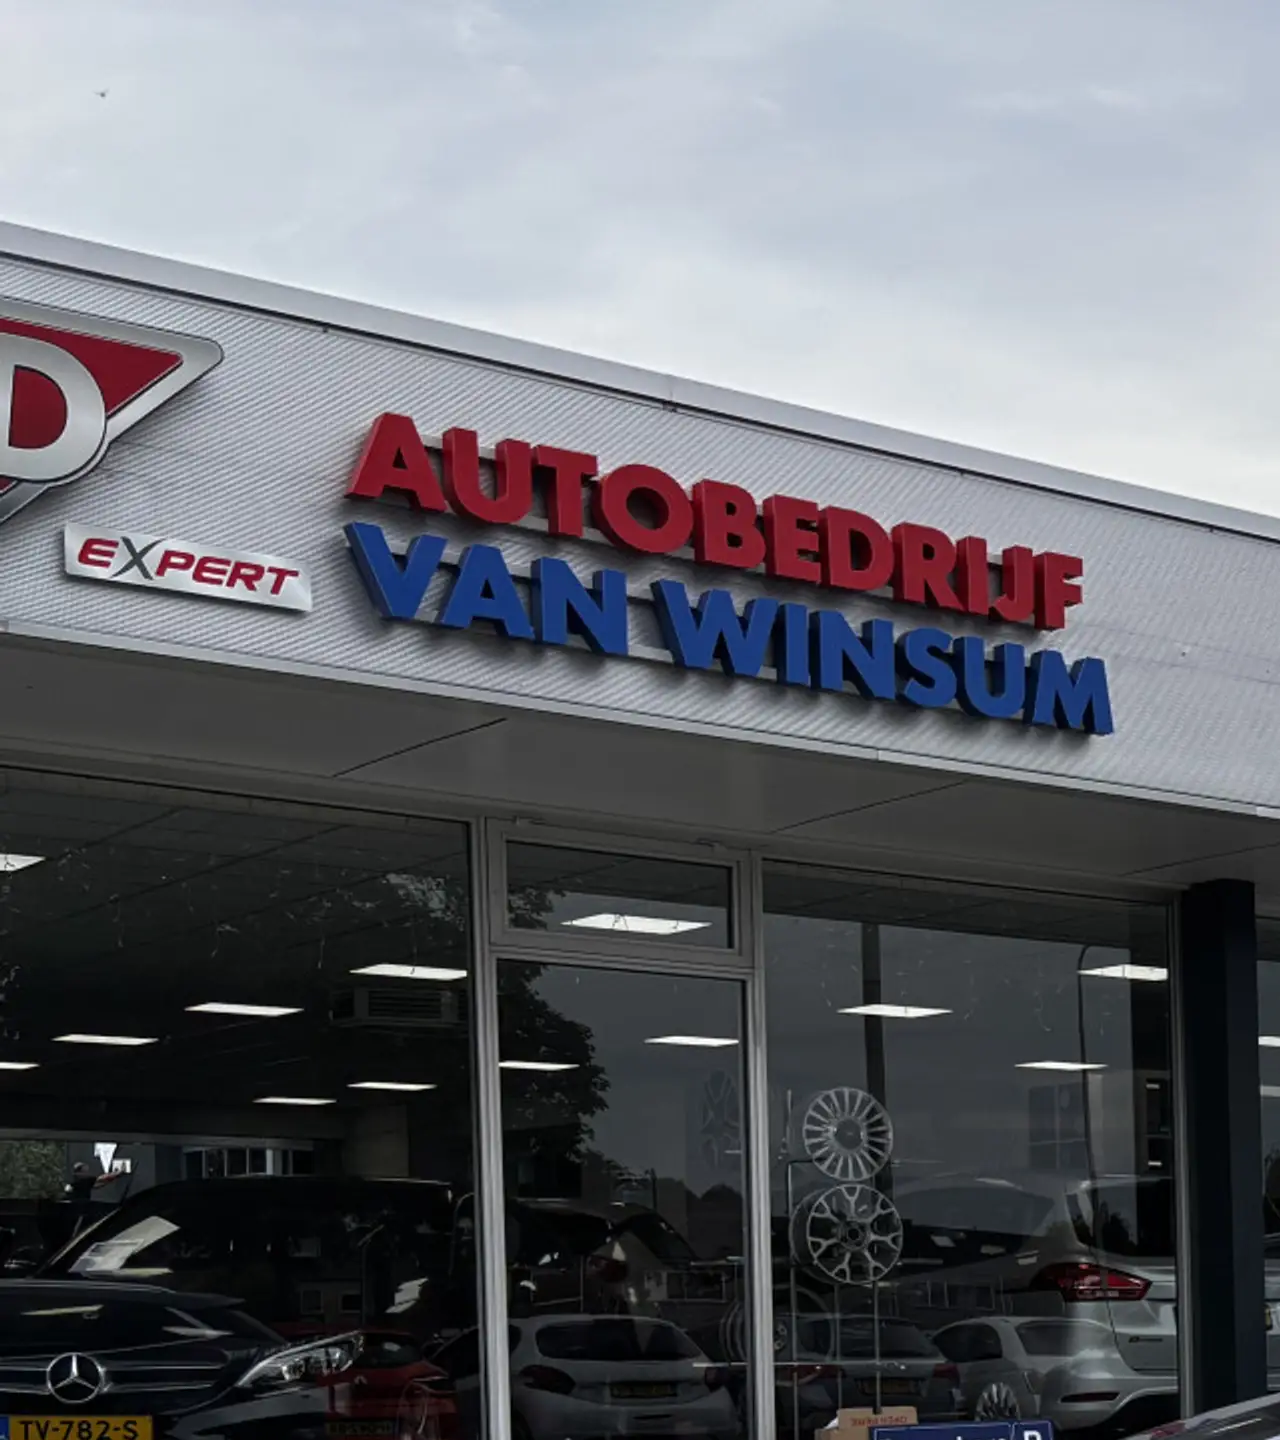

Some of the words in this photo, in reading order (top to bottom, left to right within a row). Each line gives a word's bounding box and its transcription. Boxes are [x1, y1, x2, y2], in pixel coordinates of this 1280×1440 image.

[77, 536, 300, 596] EXPERT
[345, 412, 1083, 630] AUTOBEDRIJF
[344, 521, 628, 654] VAN
[651, 578, 1114, 735] WINSUM
[19, 1419, 139, 1440] TV-782-S
